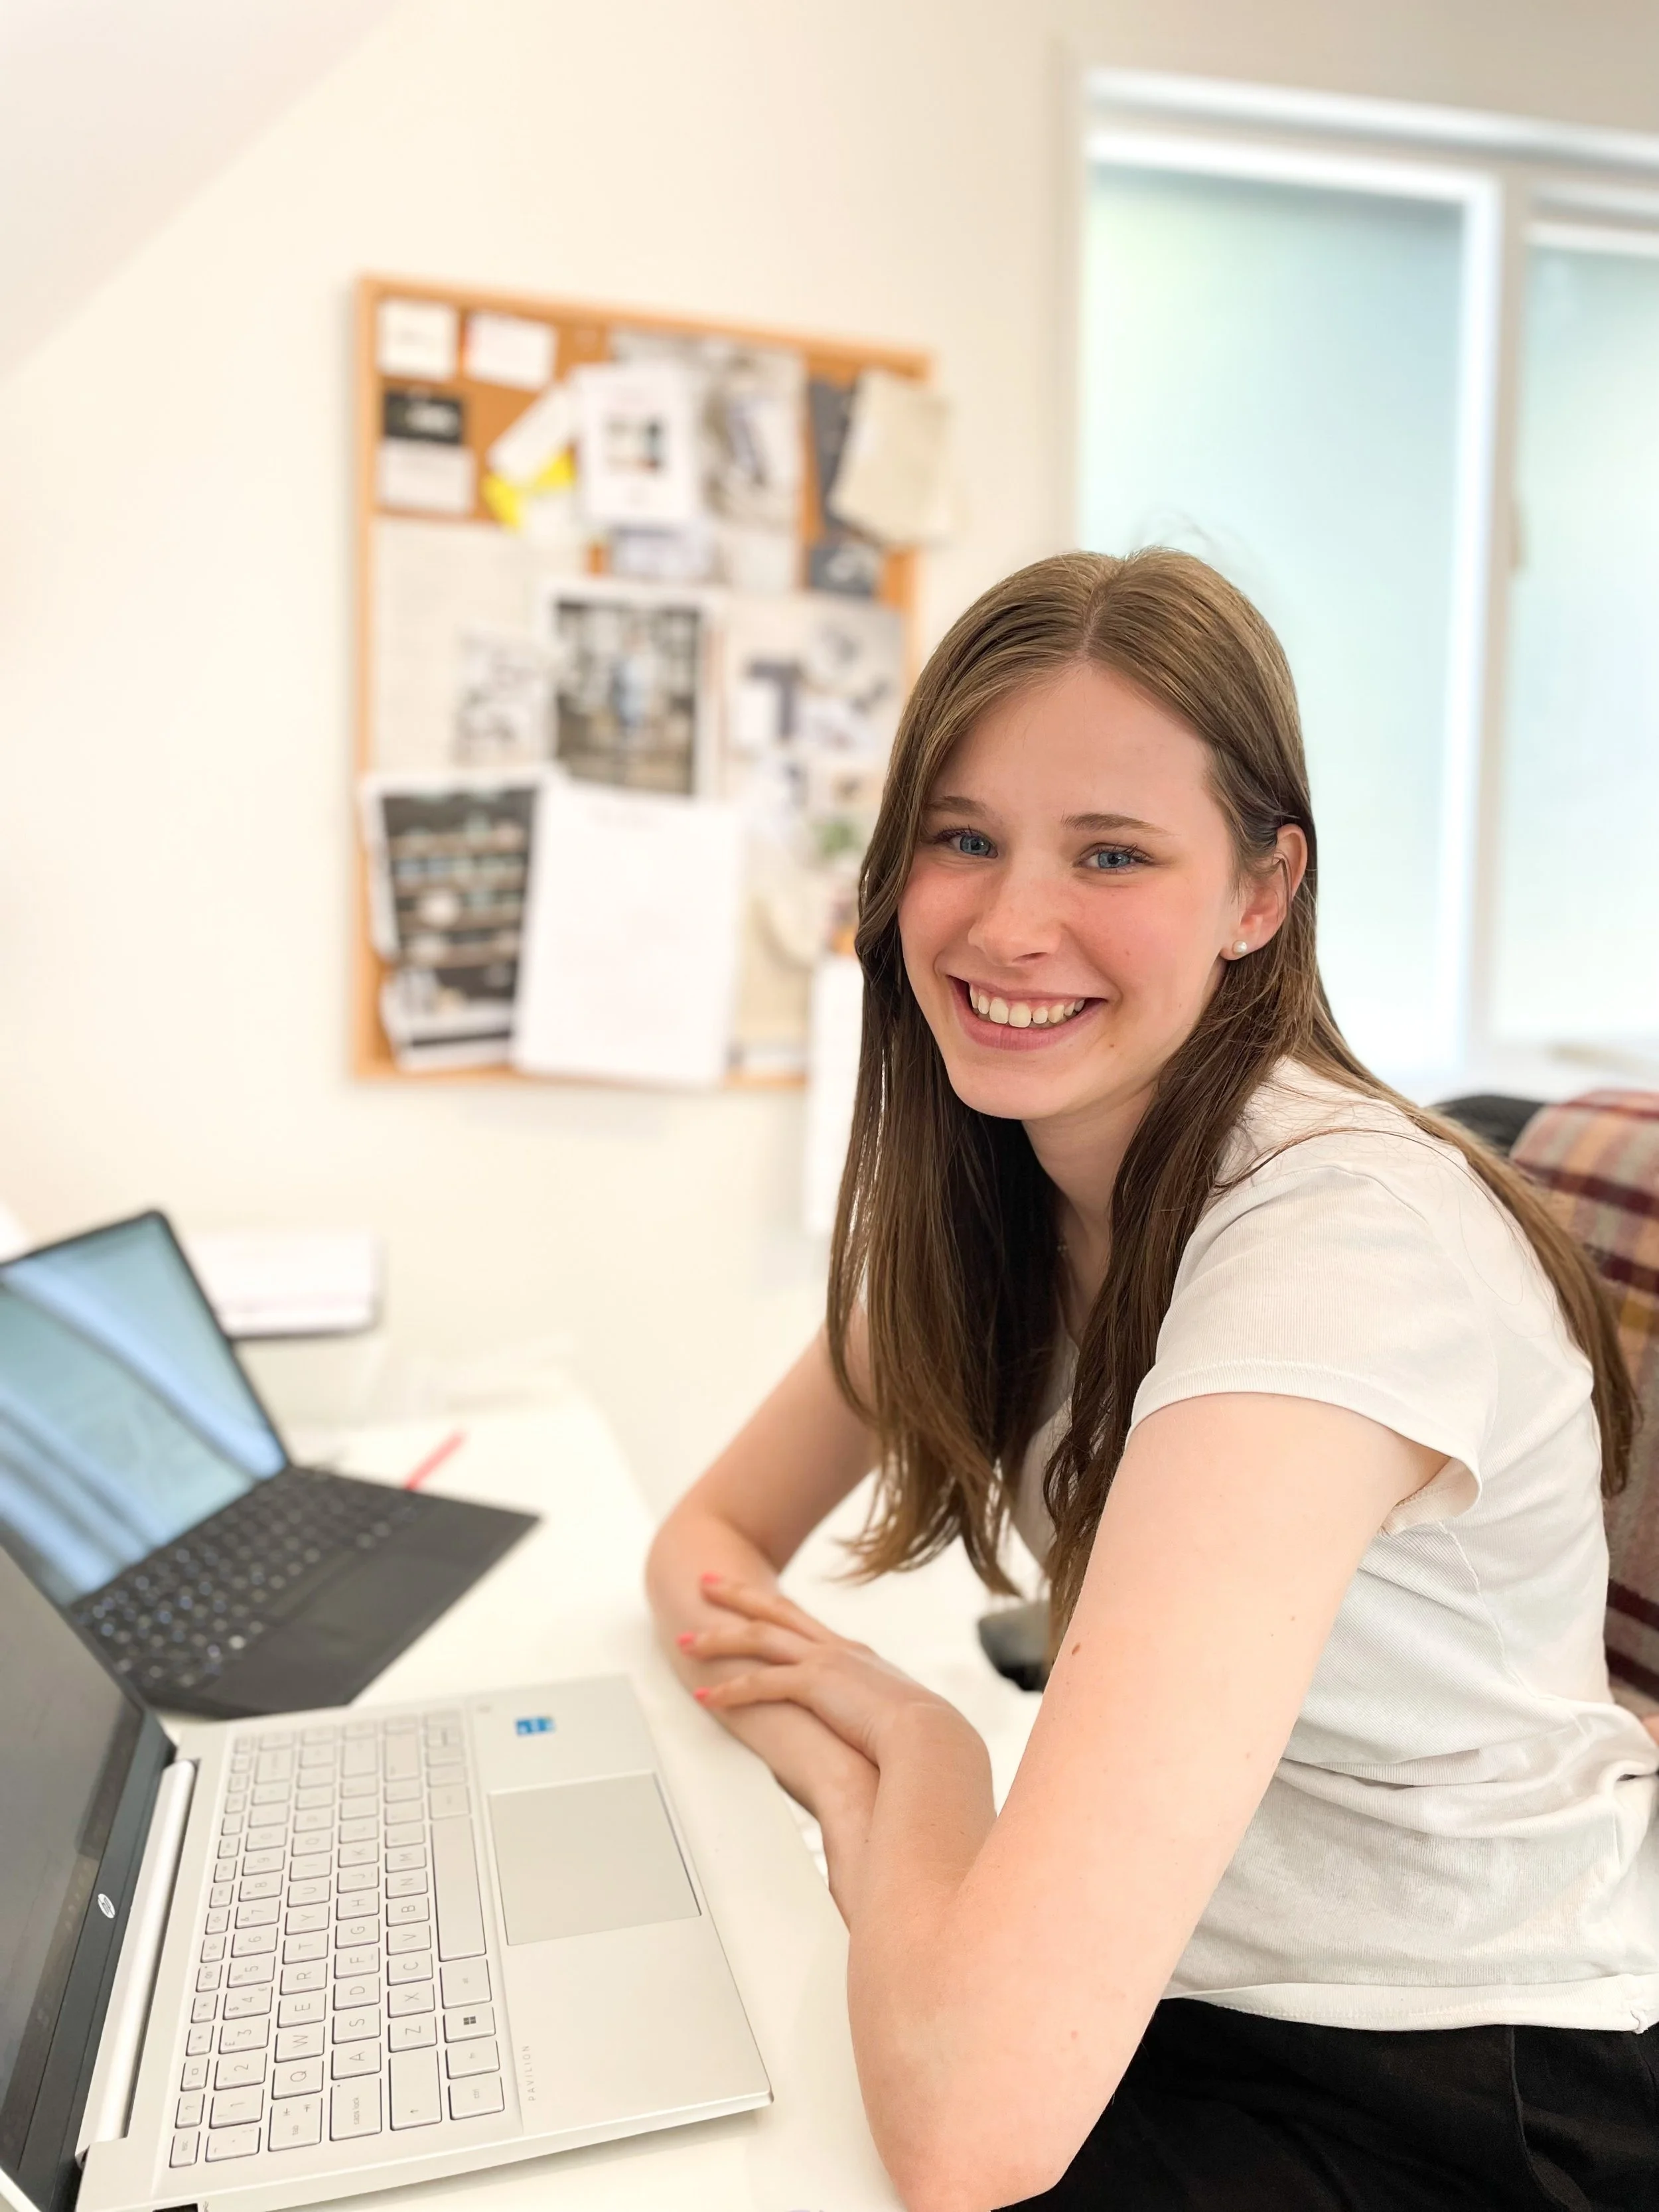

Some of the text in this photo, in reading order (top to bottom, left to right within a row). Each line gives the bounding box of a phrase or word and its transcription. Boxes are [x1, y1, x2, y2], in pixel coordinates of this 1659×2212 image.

[399, 1853, 413, 1862] M
[98, 1893, 115, 1919] hp
[298, 1943, 313, 1951] T
[403, 1961, 419, 1971] C
[296, 1971, 313, 1980] R
[350, 1986, 366, 1995] D
[405, 1992, 420, 2002] X
[295, 2003, 311, 2012] E
[349, 2018, 364, 2027] S
[405, 2026, 421, 2035] Z
[293, 2035, 308, 2048] W
[349, 2051, 365, 2061] A
[290, 2071, 307, 2082] Q
[522, 2045, 536, 2101] PAVILION
